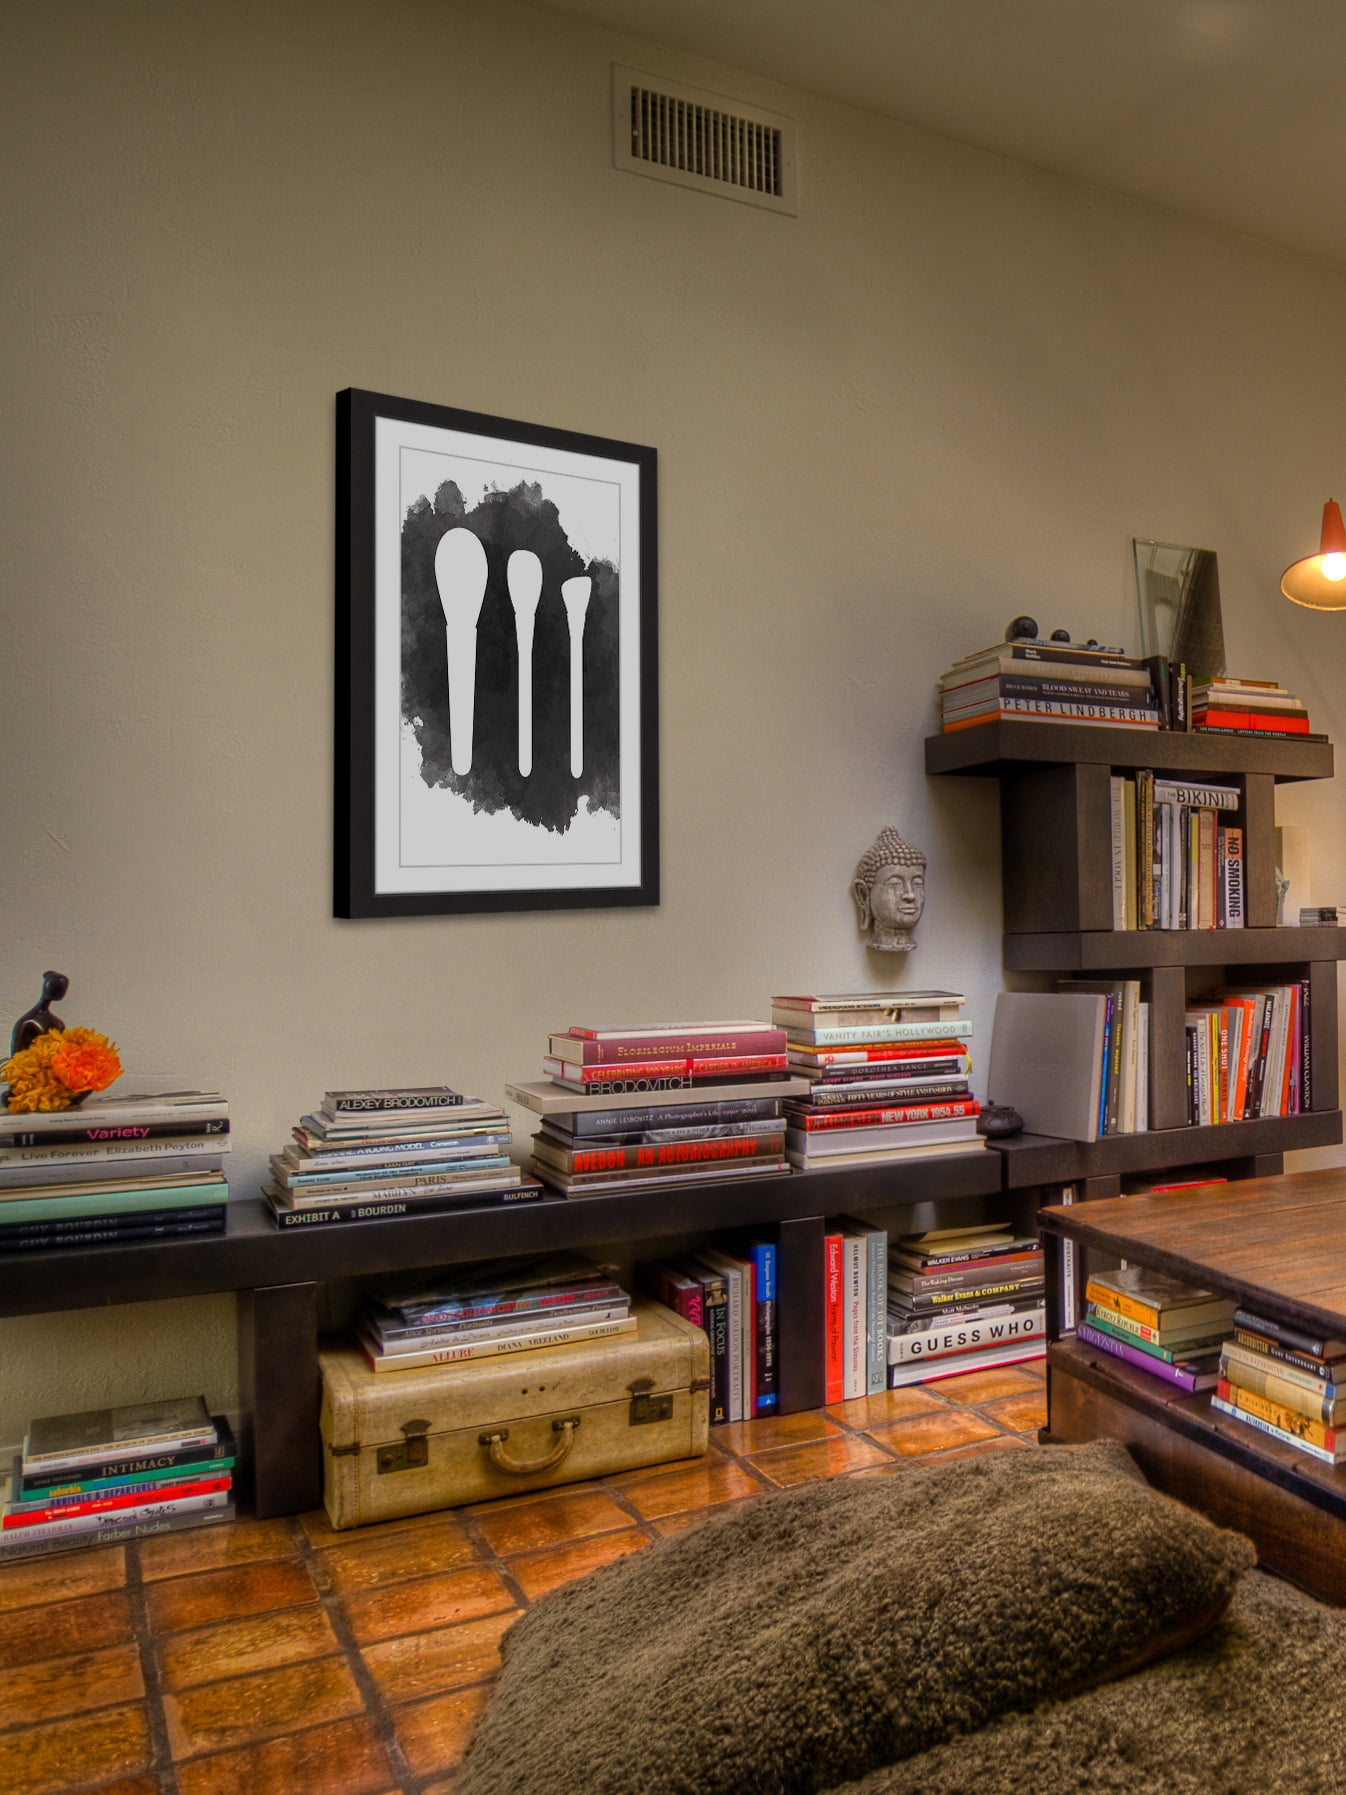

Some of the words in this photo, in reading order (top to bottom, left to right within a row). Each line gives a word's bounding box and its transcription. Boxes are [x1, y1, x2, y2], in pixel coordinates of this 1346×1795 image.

[1042, 683, 1067, 692] BLOOD
[1067, 685, 1092, 694] SWEAT
[1093, 687, 1107, 696] AND
[1108, 689, 1130, 697] TEARS
[1004, 698, 1052, 713] PETER
[1060, 704, 1147, 721] LINDBERGH
[1176, 788, 1226, 808] BIKINI
[1227, 836, 1240, 855] NO
[1228, 859, 1240, 918] SMOKING
[823, 1032, 857, 1041] VANITY
[862, 1029, 891, 1039] FAIR'S
[895, 1026, 956, 1037] HOLLYWOOD
[851, 1065, 898, 1075] DOROTHEA
[901, 1063, 928, 1072] LANGE
[589, 1076, 693, 1096] BRODOVITCH
[340, 1099, 381, 1110] ALEXEY
[384, 1095, 456, 1108] BRODOVITCH
[596, 1117, 618, 1126] ANNIE
[620, 1114, 654, 1124] LEIBOVITZ
[881, 1111, 903, 1123] NEW
[903, 1108, 928, 1121] YORK
[86, 1126, 150, 1140] Variety
[22, 1151, 47, 1161] Live
[50, 1149, 99, 1159] Forever
[106, 1143, 162, 1155] Elizabeth
[164, 1141, 204, 1151] Peyton
[395, 1142, 424, 1151] MODEL
[575, 1149, 625, 1171] AVEDON
[637, 1147, 654, 1165] AN
[658, 1137, 758, 1163] AUTOBIOGRAPHY
[415, 1175, 448, 1186] PARIS
[503, 1191, 538, 1201] BULFINCH
[285, 1211, 329, 1225] EXHIBIT
[332, 1211, 341, 1220] A
[358, 1203, 407, 1217] BOURDIN
[830, 1244, 838, 1272] Edward
[876, 1243, 884, 1260] THE
[927, 1257, 951, 1266] WALKER
[951, 1254, 969, 1263] EVANS
[876, 1263, 884, 1291] BOOK
[830, 1273, 838, 1302] Weston
[931, 1294, 954, 1304] Walker
[955, 1291, 974, 1300] Evans
[974, 1289, 981, 1297] &
[981, 1283, 1020, 1296] COMPANY
[876, 1293, 884, 1307] OF
[716, 1307, 726, 1319] IN
[716, 1322, 726, 1355] FOCUS
[876, 1329, 884, 1362] BOOKS
[911, 1330, 981, 1355] GUESS
[989, 1319, 1035, 1339] WHO
[432, 1347, 474, 1362] ALLURE
[497, 1341, 522, 1351] DIANA
[528, 1333, 570, 1346] VREELAND
[102, 1455, 176, 1477] INTIMACY
[50, 1492, 92, 1508] ARRIVALS
[104, 1481, 157, 1497] DEPARTURES
[97, 1527, 131, 1540] Farber
[136, 1520, 171, 1535] Nudes
